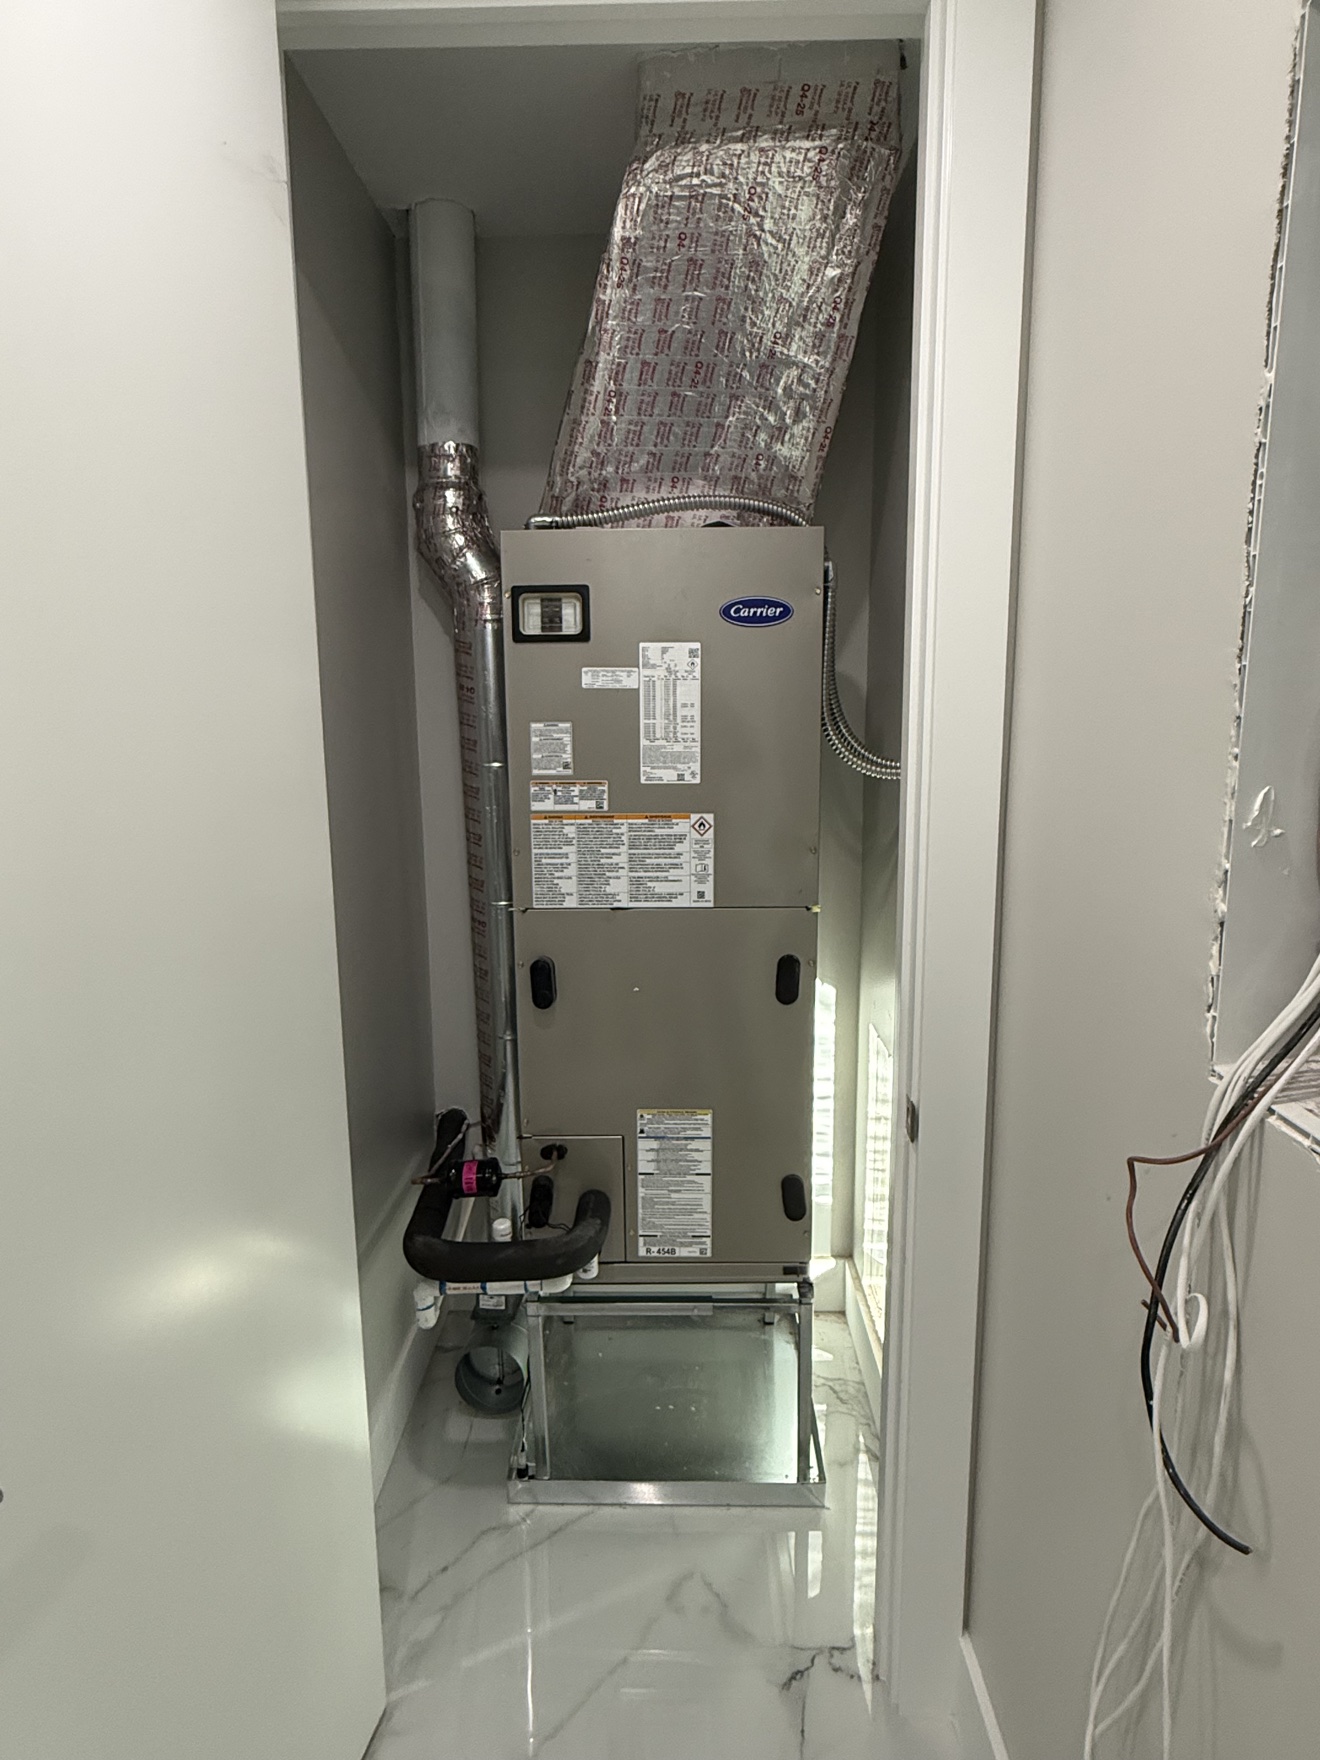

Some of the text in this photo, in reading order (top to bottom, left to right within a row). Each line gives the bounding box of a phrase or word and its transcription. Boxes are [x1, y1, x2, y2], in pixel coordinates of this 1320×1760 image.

[795, 83, 811, 117] Q4-25
[742, 185, 757, 221] Q4-25
[730, 604, 784, 618] Carrier
